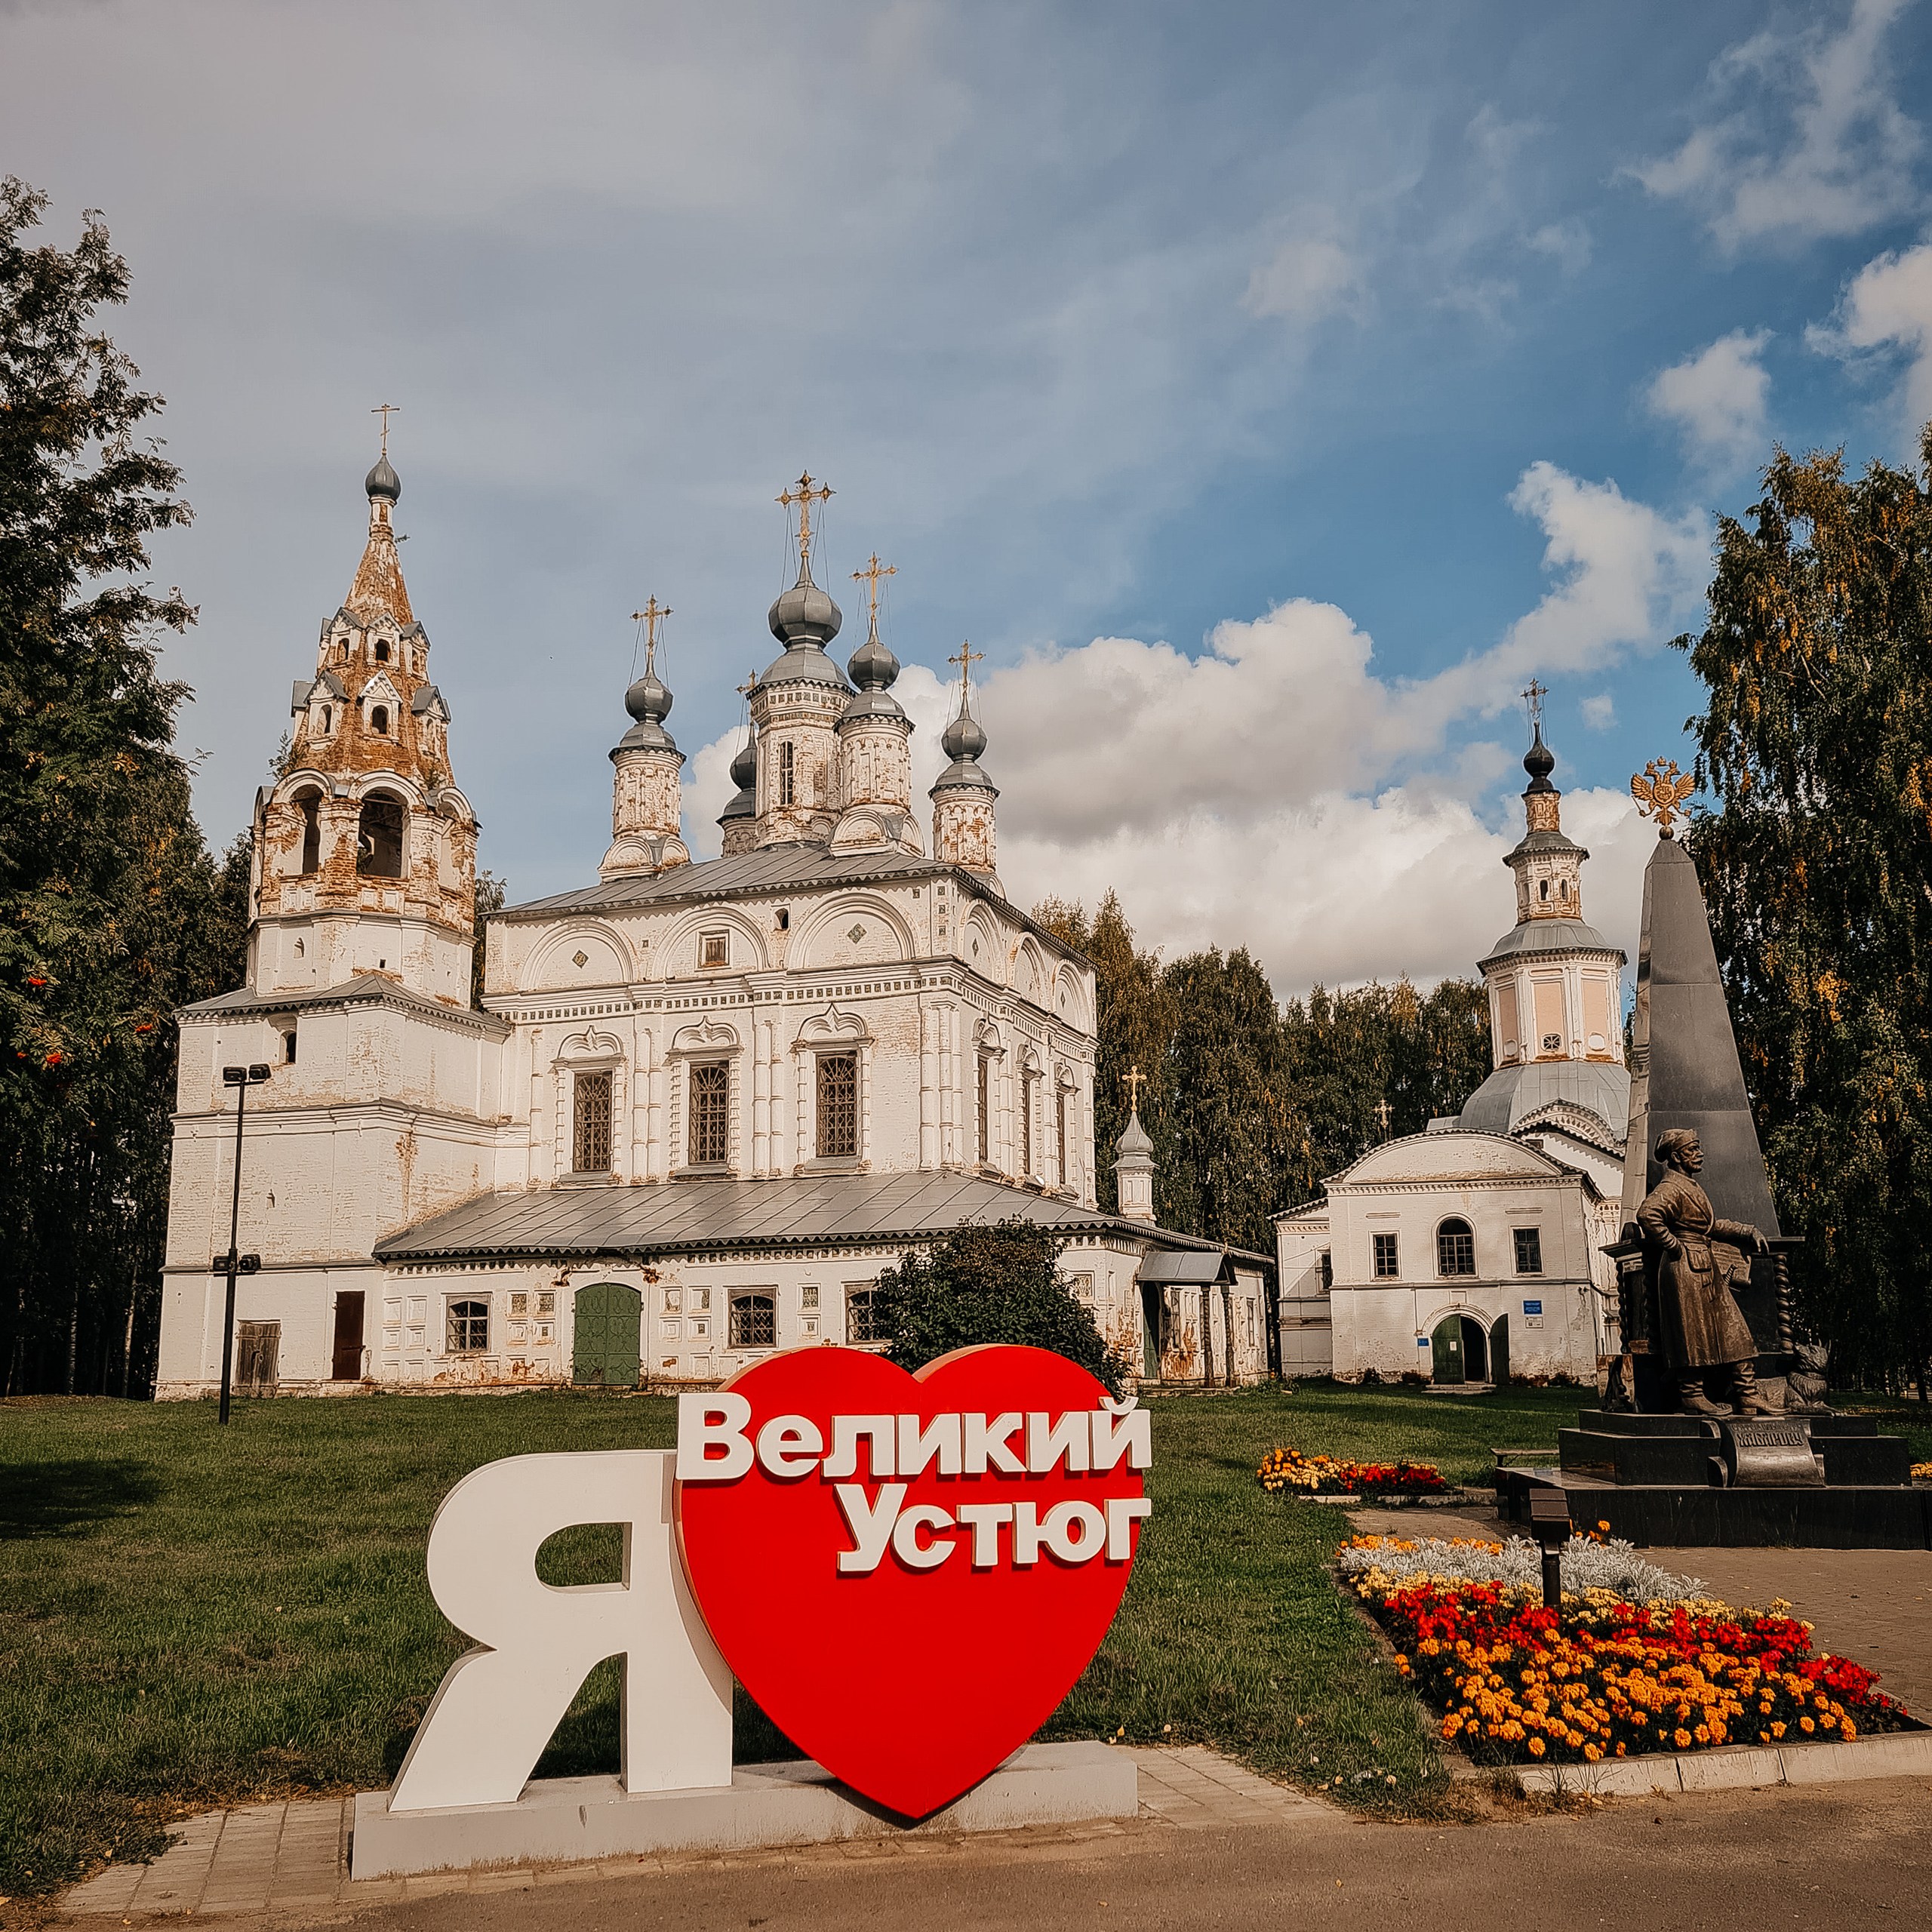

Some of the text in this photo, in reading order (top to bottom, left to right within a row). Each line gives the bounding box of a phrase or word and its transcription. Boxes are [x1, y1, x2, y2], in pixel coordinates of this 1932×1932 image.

[675, 1391, 1153, 1481] Великий
[834, 1483, 1153, 1572] Устюг
[388, 1448, 733, 1813] Я
